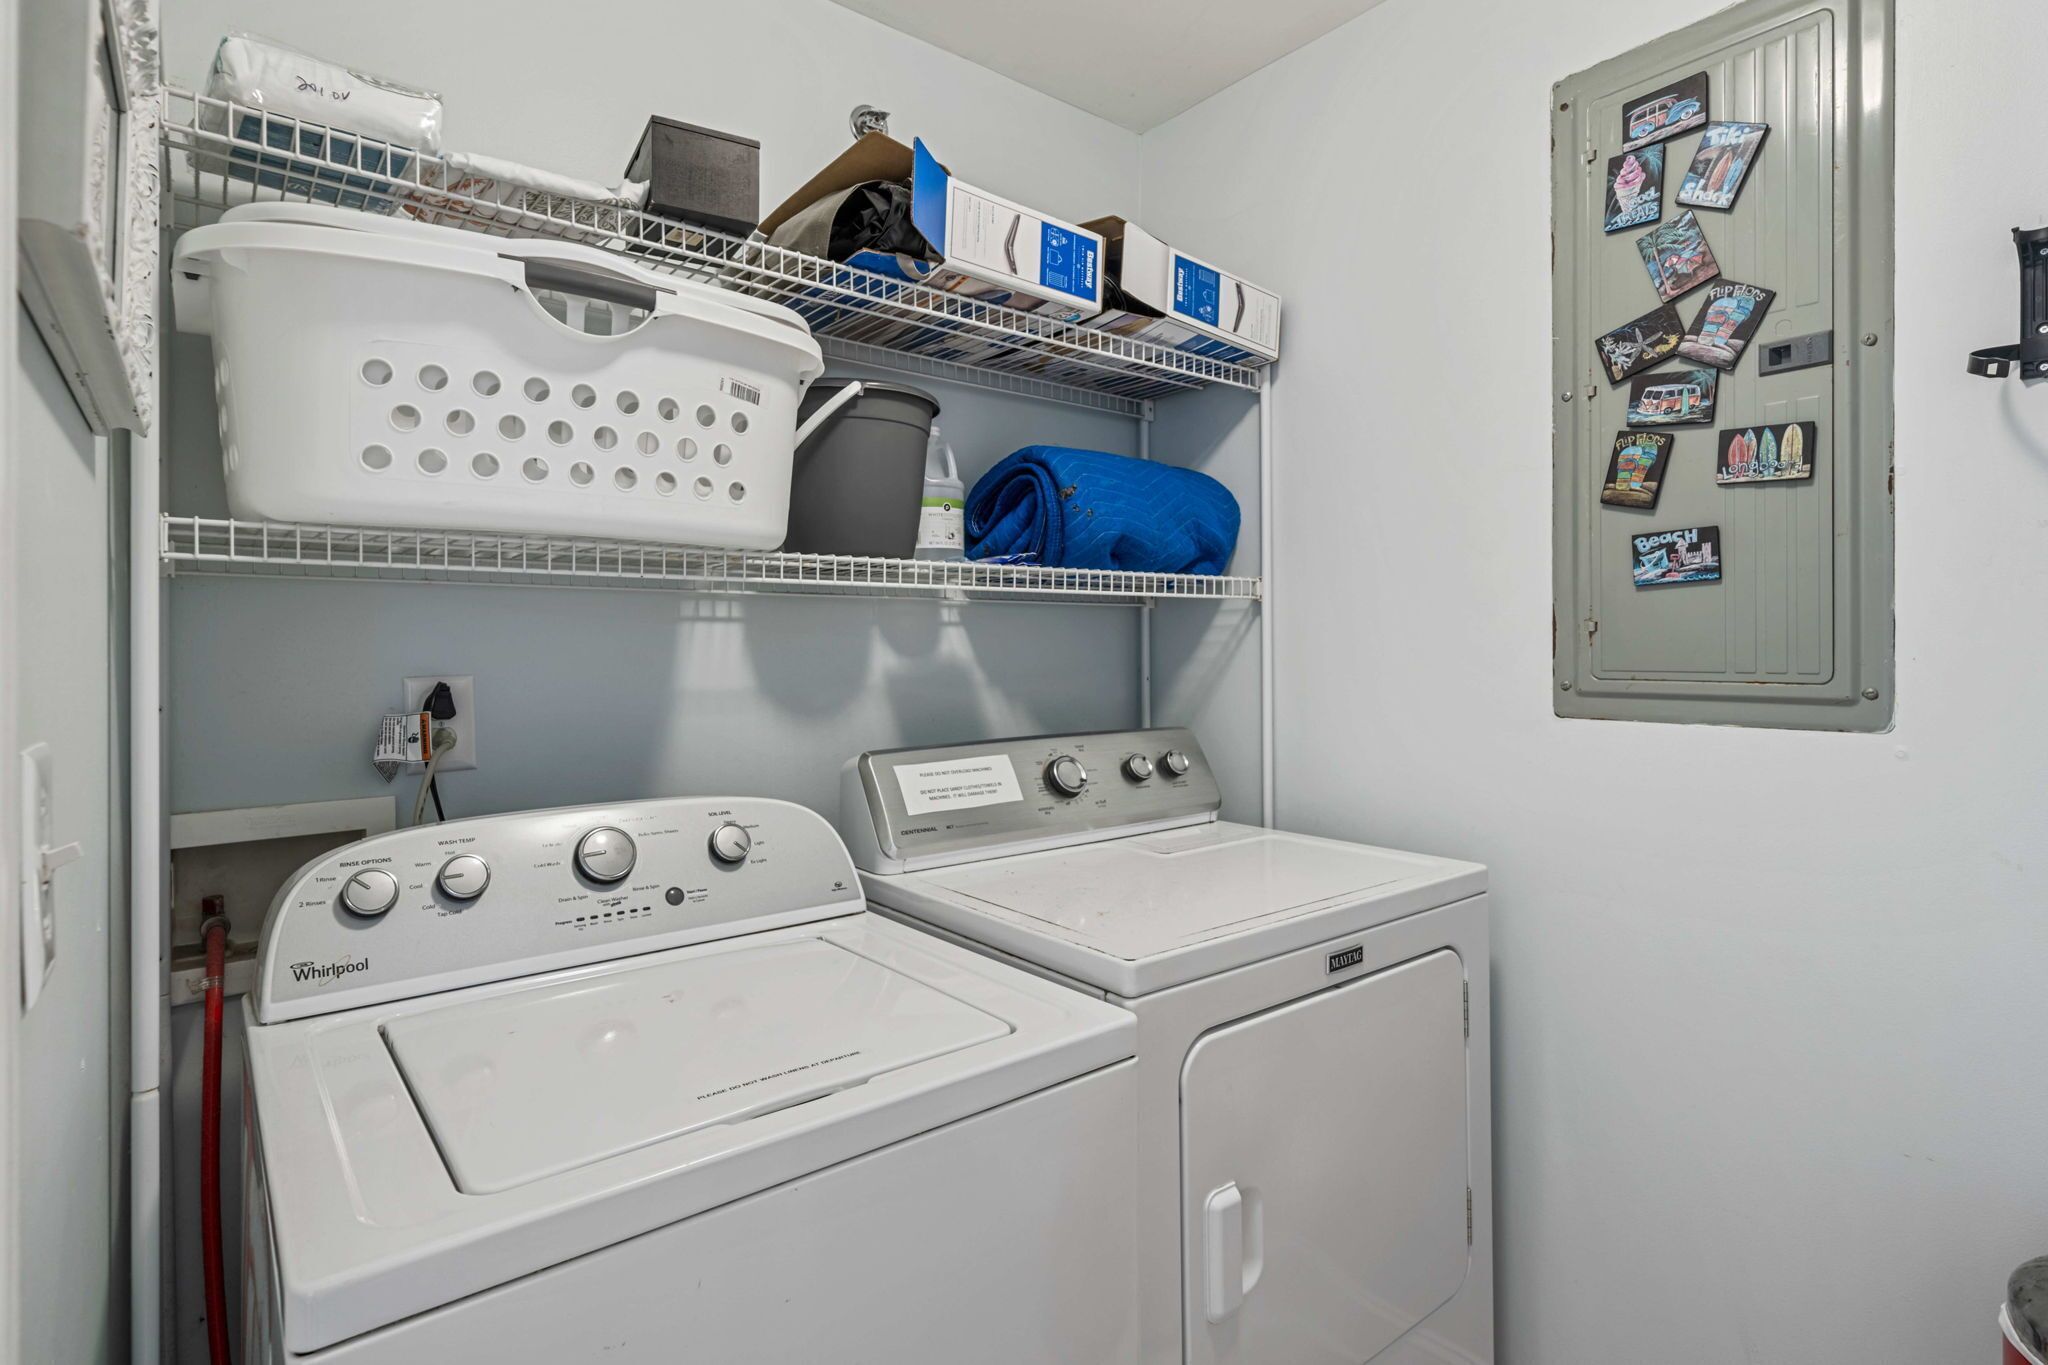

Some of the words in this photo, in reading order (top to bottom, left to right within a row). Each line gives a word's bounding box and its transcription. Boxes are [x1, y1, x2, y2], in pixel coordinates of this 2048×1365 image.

[1085, 250, 1094, 288] Bestway
[900, 826, 938, 836] CENTENNIAL
[339, 860, 360, 868] RINSE
[361, 857, 392, 865] OPTIONS
[292, 957, 369, 982] Whirlpool
[1330, 950, 1362, 970] MAYTAG
[696, 1088, 727, 1101] PLEASE
[729, 1084, 742, 1092] DO
[742, 1079, 758, 1087] NOT
[760, 1072, 783, 1082] WASH
